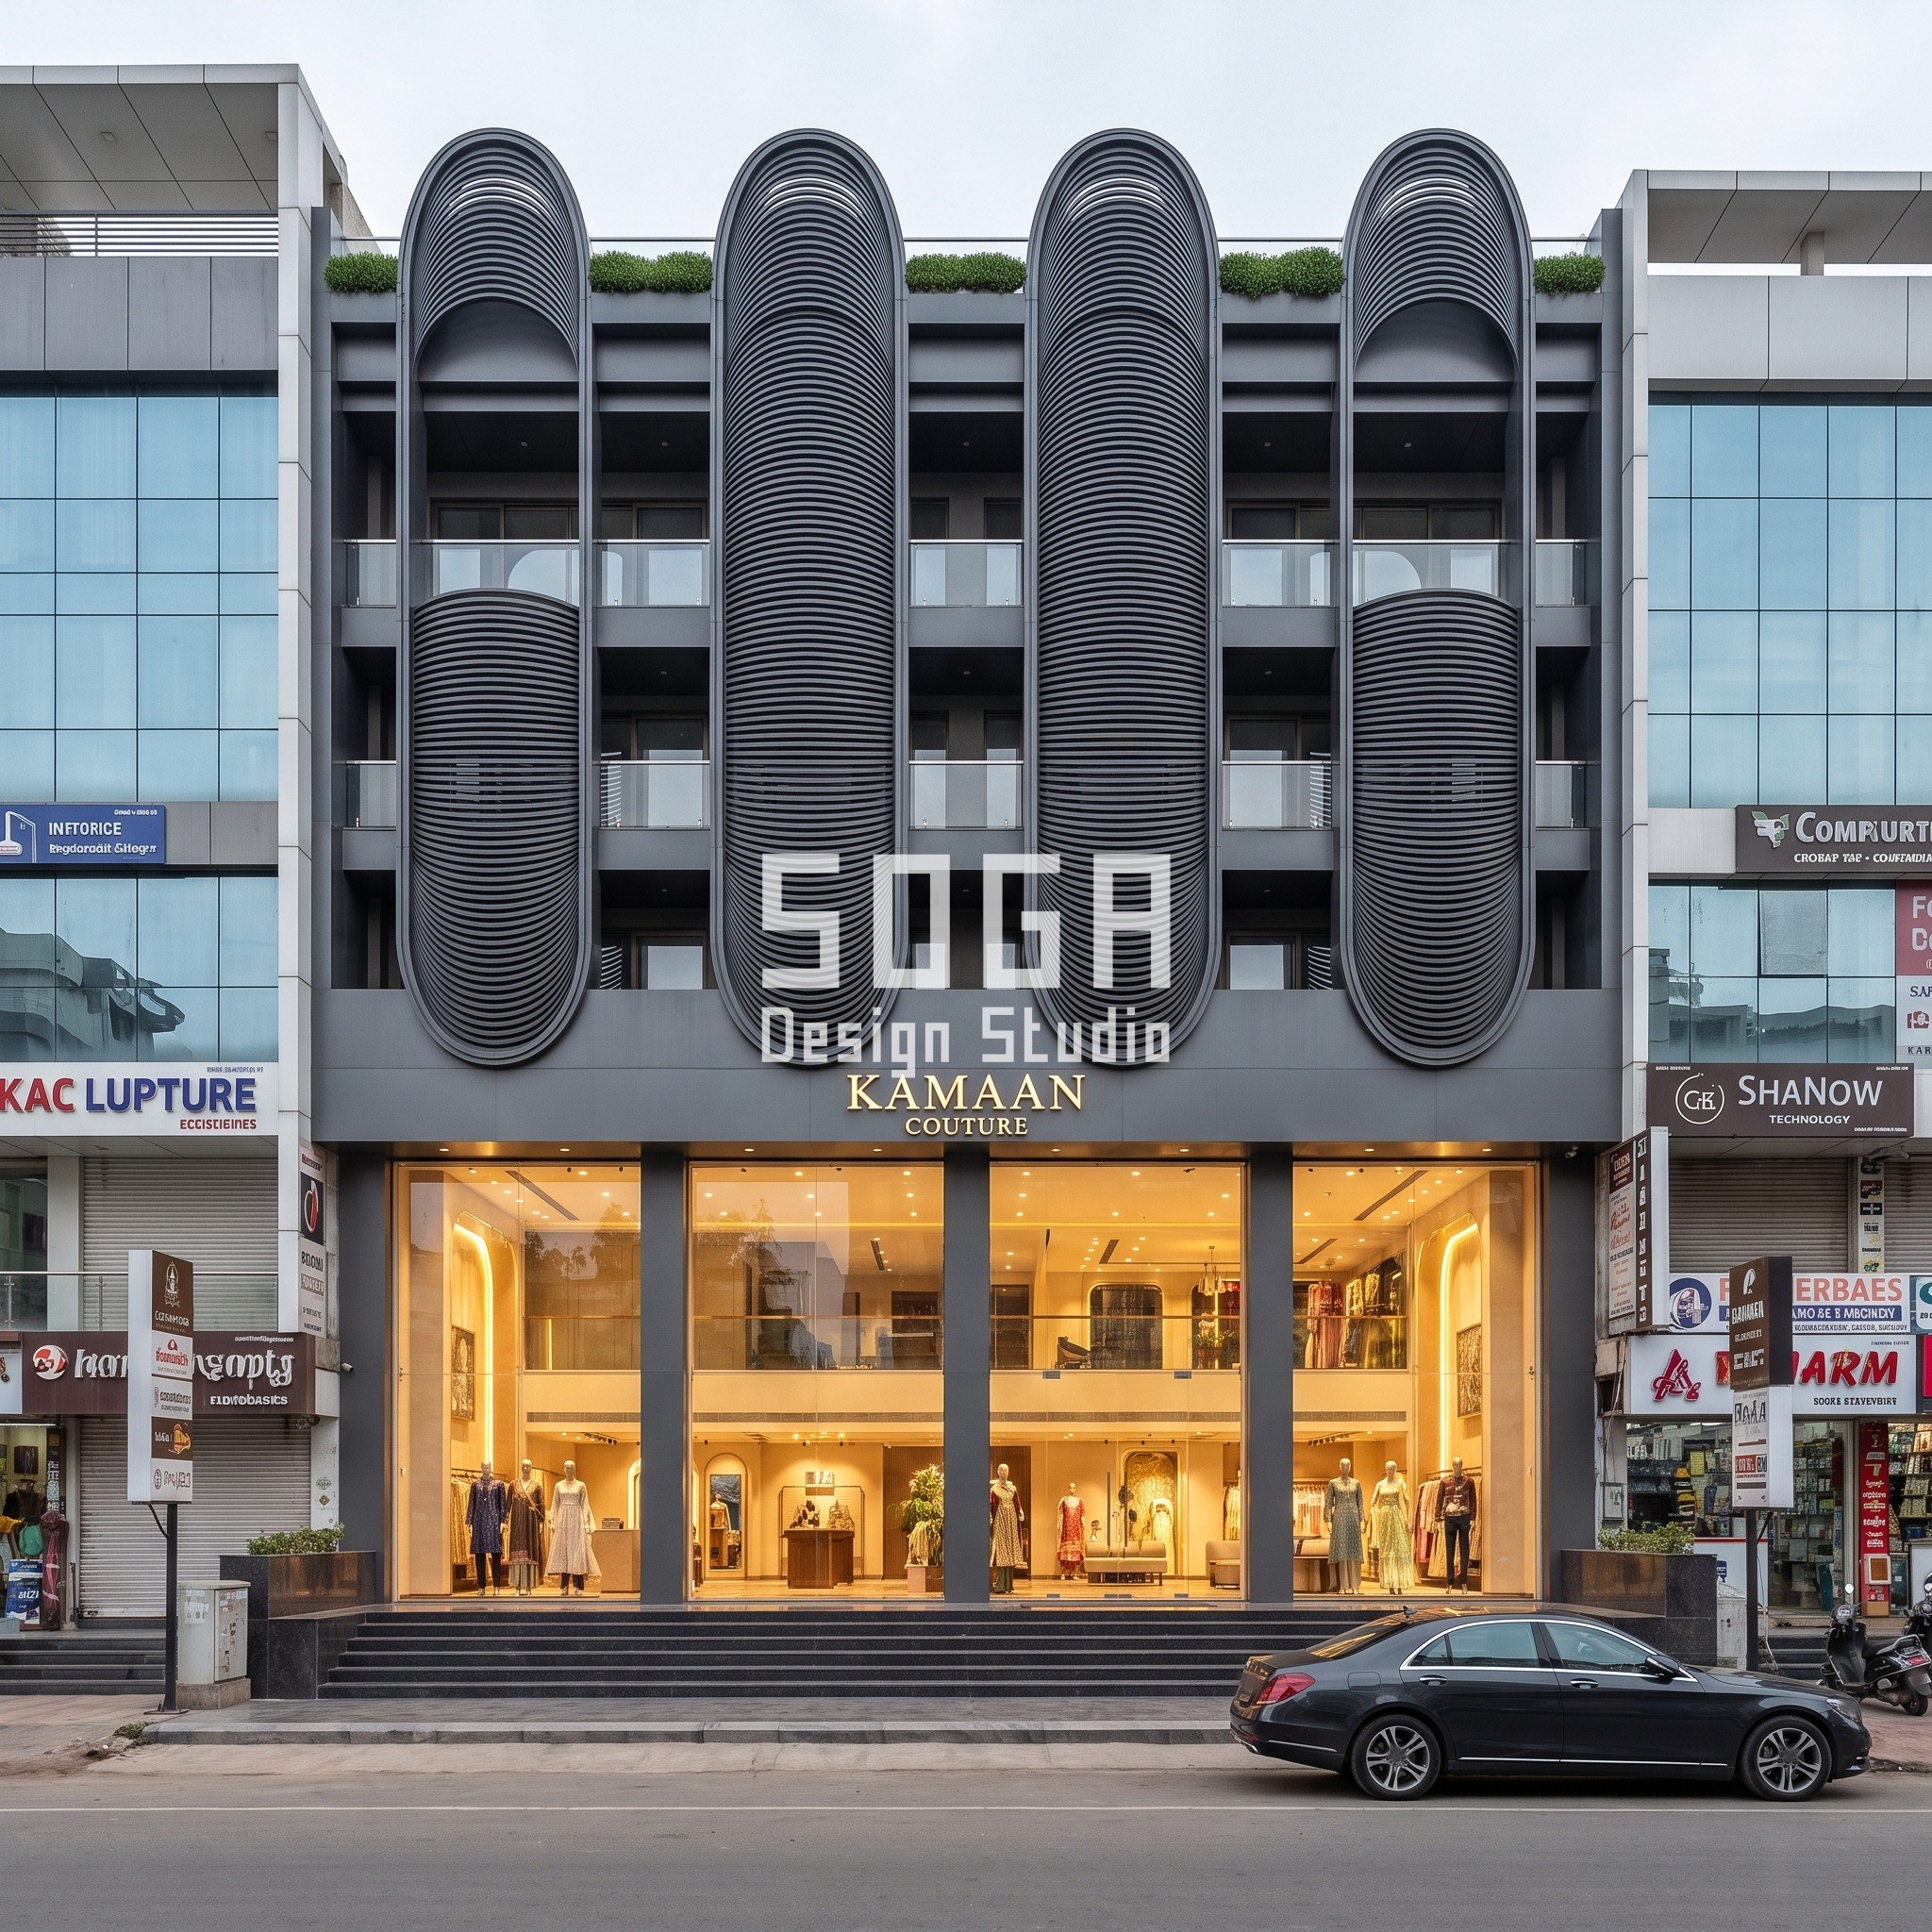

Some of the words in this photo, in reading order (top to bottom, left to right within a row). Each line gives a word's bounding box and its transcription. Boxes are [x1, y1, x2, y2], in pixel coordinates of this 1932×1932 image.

[86, 1077, 258, 1113] LUPTURE
[847, 1074, 1086, 1110] KAMAAN
[905, 1117, 1028, 1136] COUTURE
[1770, 1114, 1851, 1125] TECHNOLOGY
